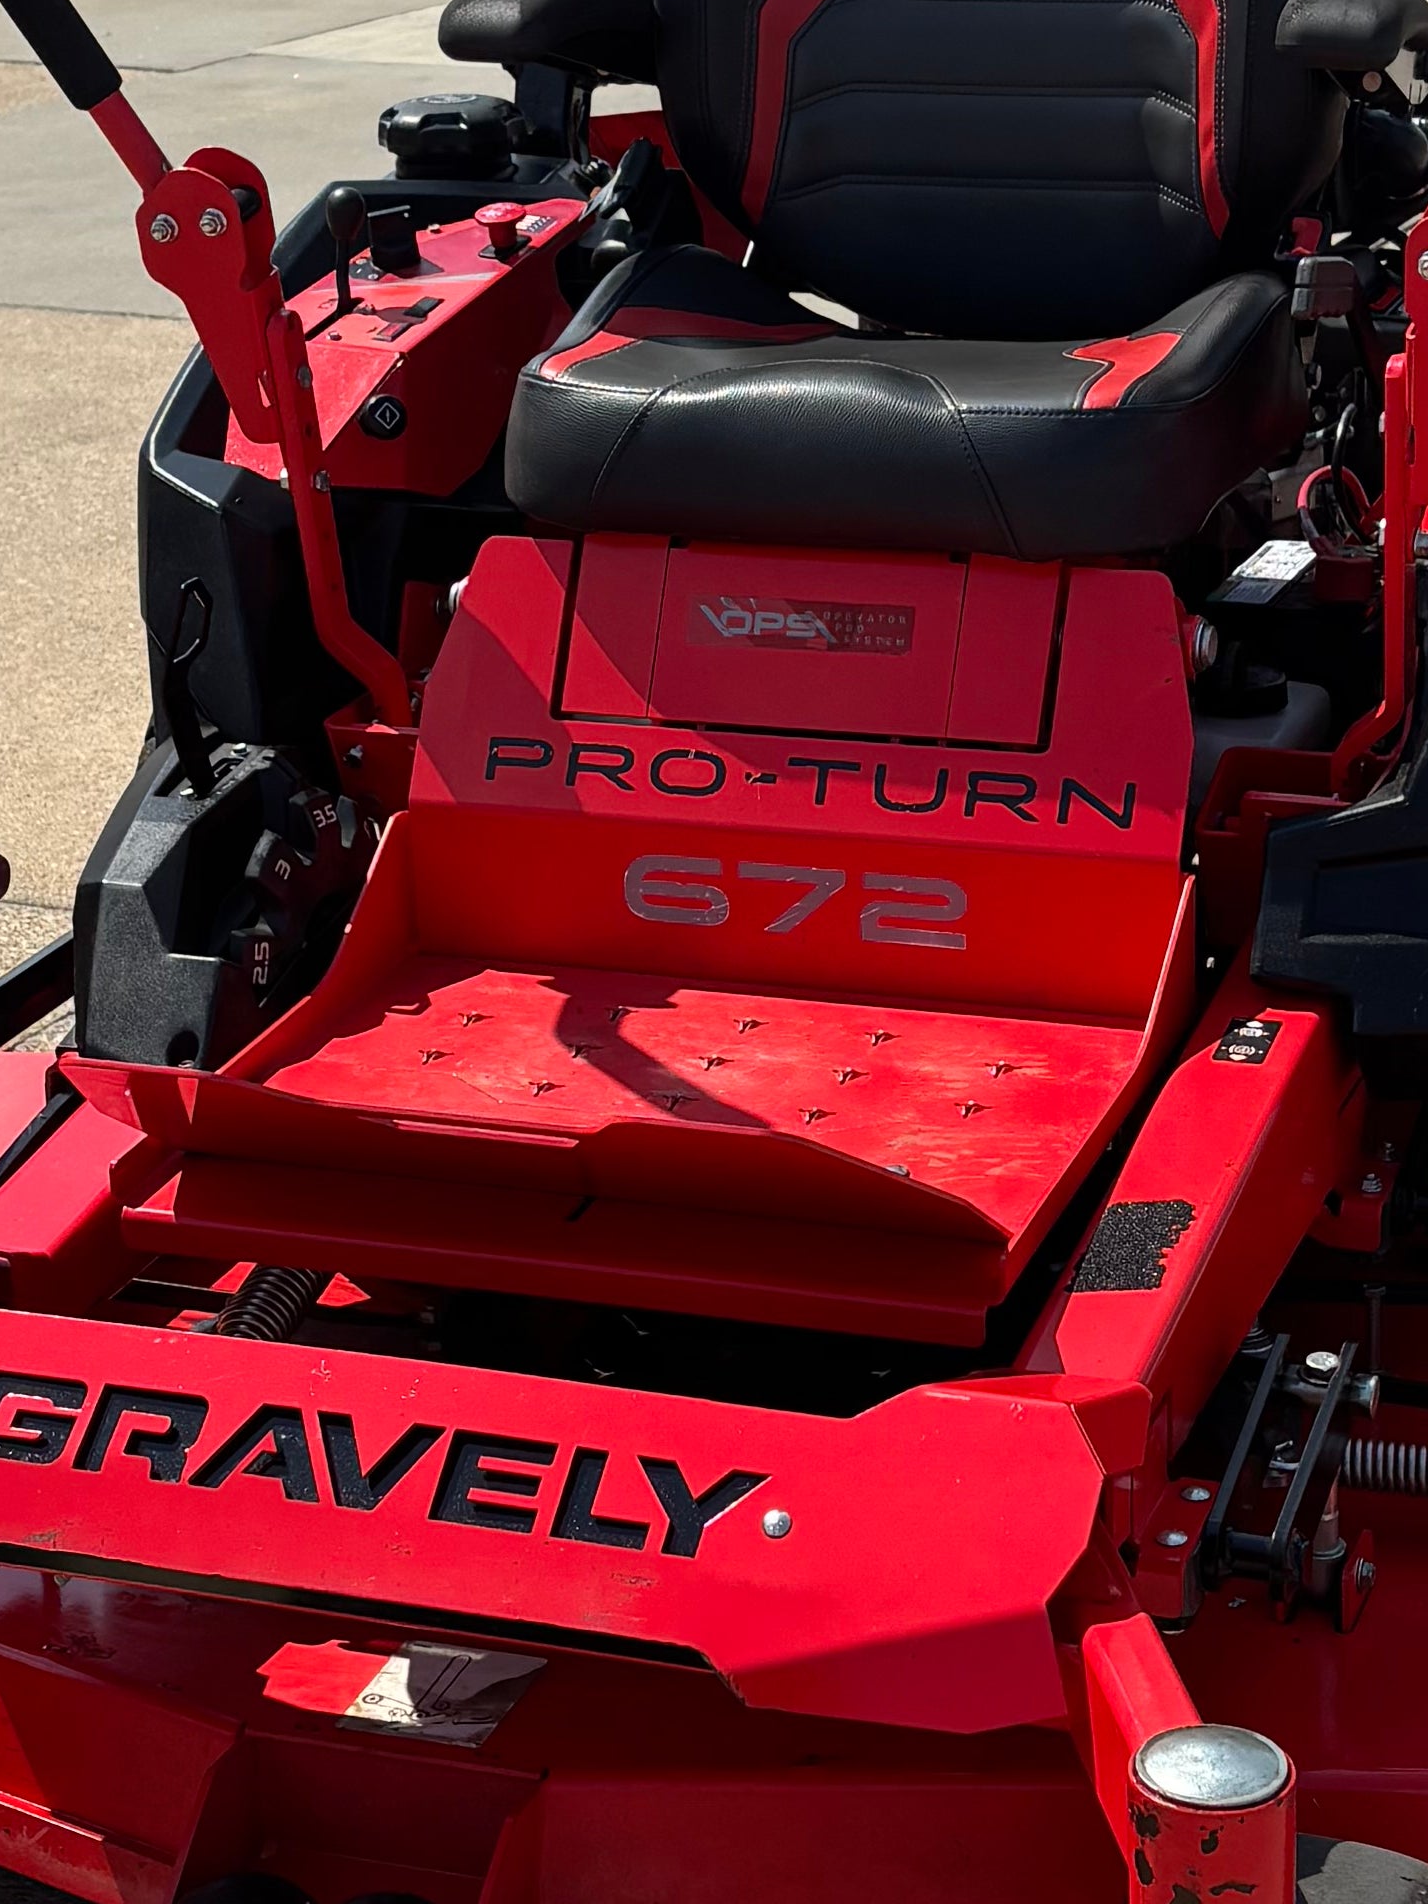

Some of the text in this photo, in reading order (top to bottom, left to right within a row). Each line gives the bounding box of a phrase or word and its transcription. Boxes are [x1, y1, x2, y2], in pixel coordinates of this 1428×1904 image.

[484, 737, 1137, 830] PRO-TURN
[274, 859, 291, 880] 3
[624, 854, 968, 950] 672
[253, 942, 269, 985] 2.5
